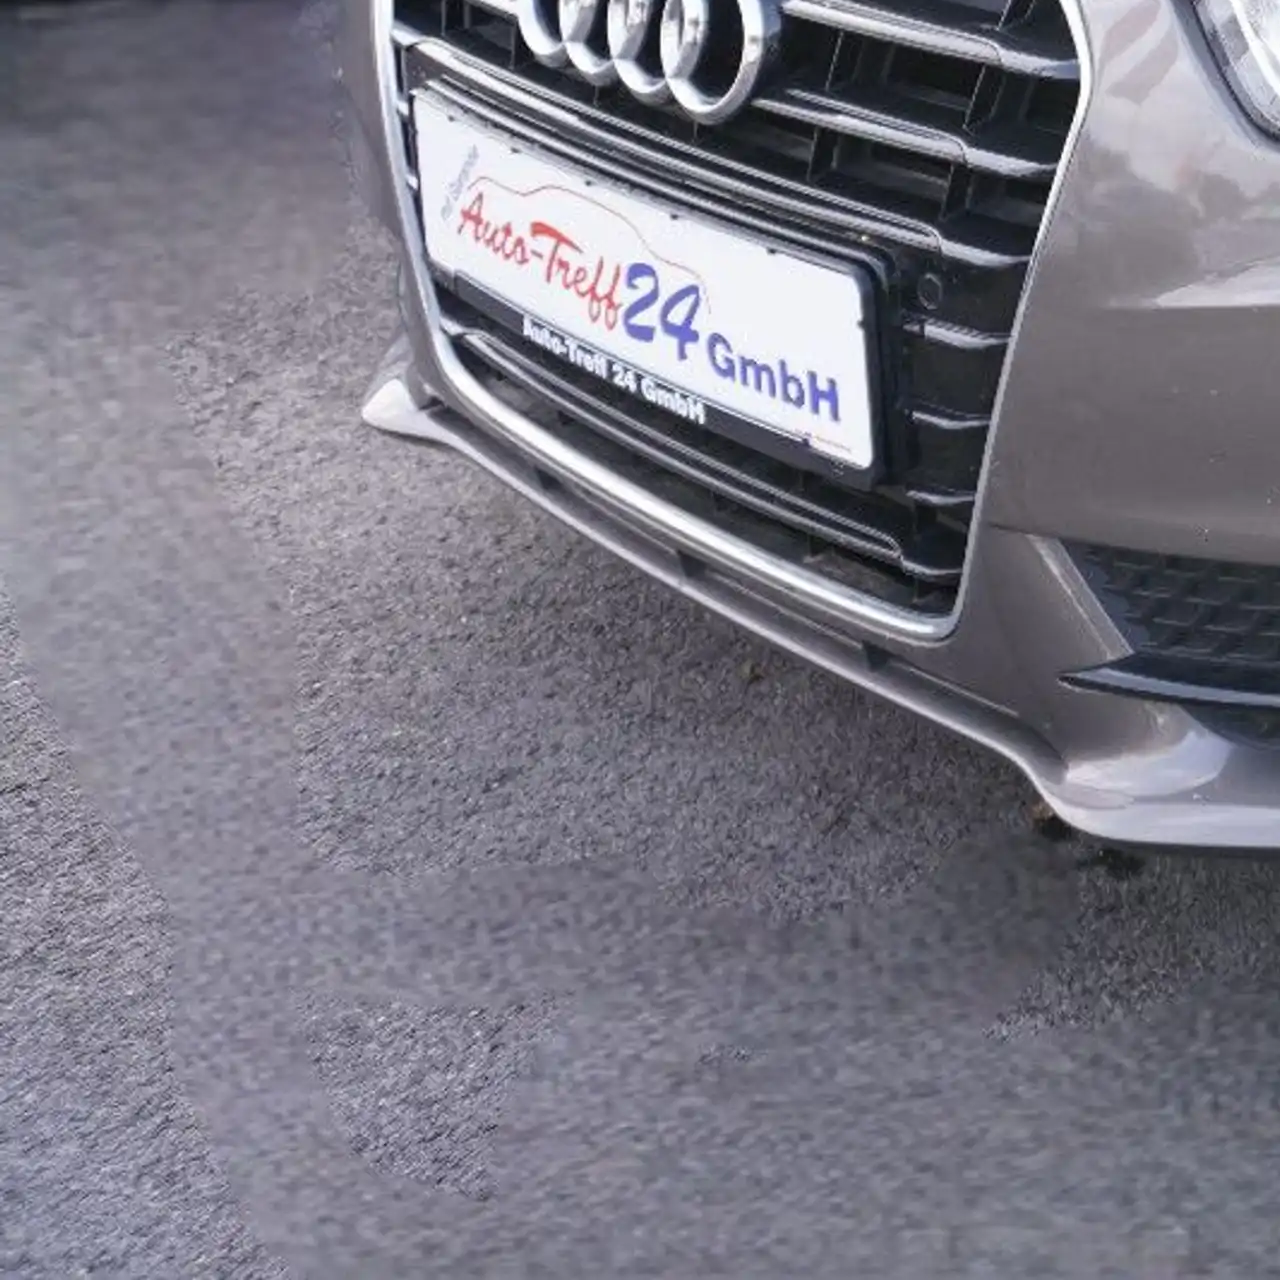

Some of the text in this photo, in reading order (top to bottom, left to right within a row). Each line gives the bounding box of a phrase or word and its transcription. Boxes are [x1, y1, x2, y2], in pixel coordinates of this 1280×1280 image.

[523, 313, 706, 424] Auto-Treff 24 GmbH
[707, 332, 841, 422] GmbH
